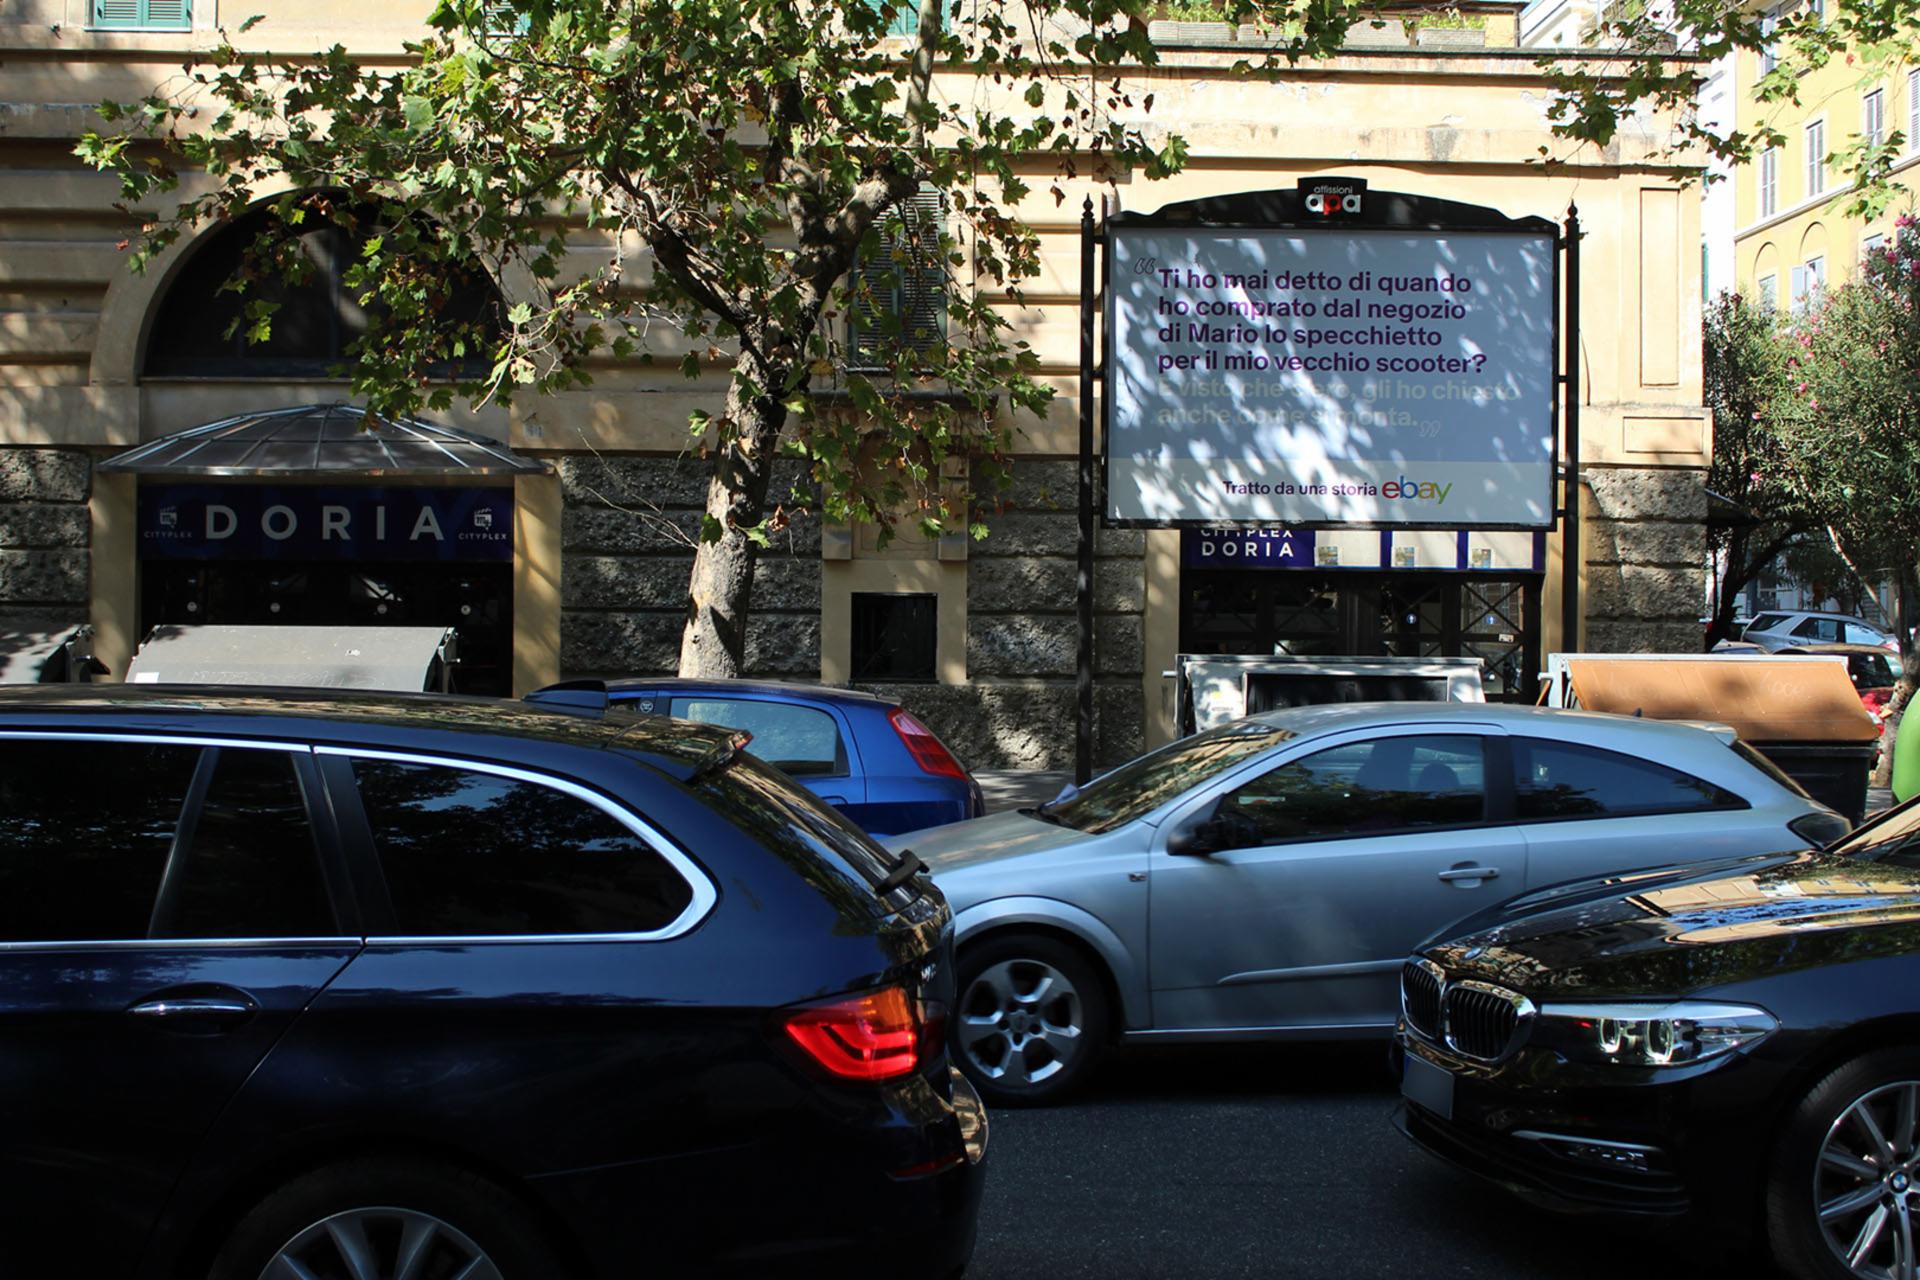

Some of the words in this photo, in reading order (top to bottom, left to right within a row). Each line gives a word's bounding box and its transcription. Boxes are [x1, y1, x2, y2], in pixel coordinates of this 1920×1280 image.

[1313, 185, 1353, 194] affissioni
[1305, 193, 1361, 215] apa
[1187, 269, 1217, 289] ho
[1224, 269, 1268, 290] mai
[1275, 270, 1342, 291] detto
[1349, 271, 1371, 291] di
[1377, 273, 1472, 296] quando
[1158, 296, 1189, 316] ho
[1195, 298, 1316, 320] comprato
[1323, 299, 1361, 318] dal
[1367, 299, 1466, 323] negozio
[1158, 323, 1181, 343] di
[1188, 323, 1259, 344] Mario
[1265, 324, 1287, 344] lo
[1293, 325, 1443, 349] specchietto
[1158, 353, 1201, 374] per
[1205, 350, 1217, 370] il
[1224, 351, 1270, 371] mio
[1274, 351, 1370, 373] vecchio
[1376, 353, 1487, 374] scooter?
[1179, 377, 1230, 398] visto
[1243, 378, 1284, 398] che
[1363, 379, 1391, 404] gli
[1396, 380, 1427, 401] ho
[1432, 380, 1520, 402] chiesto
[1158, 403, 1231, 425] anche
[1222, 480, 1270, 495] Tratto
[1275, 481, 1295, 496] da
[1299, 482, 1328, 496] una
[1331, 482, 1378, 497] storia
[1382, 475, 1452, 504] ebay
[143, 530, 193, 539] CITYPLEX
[205, 505, 444, 541] DORIA
[457, 532, 507, 541] CITYPLEX
[1201, 541, 1294, 558] DORIA
